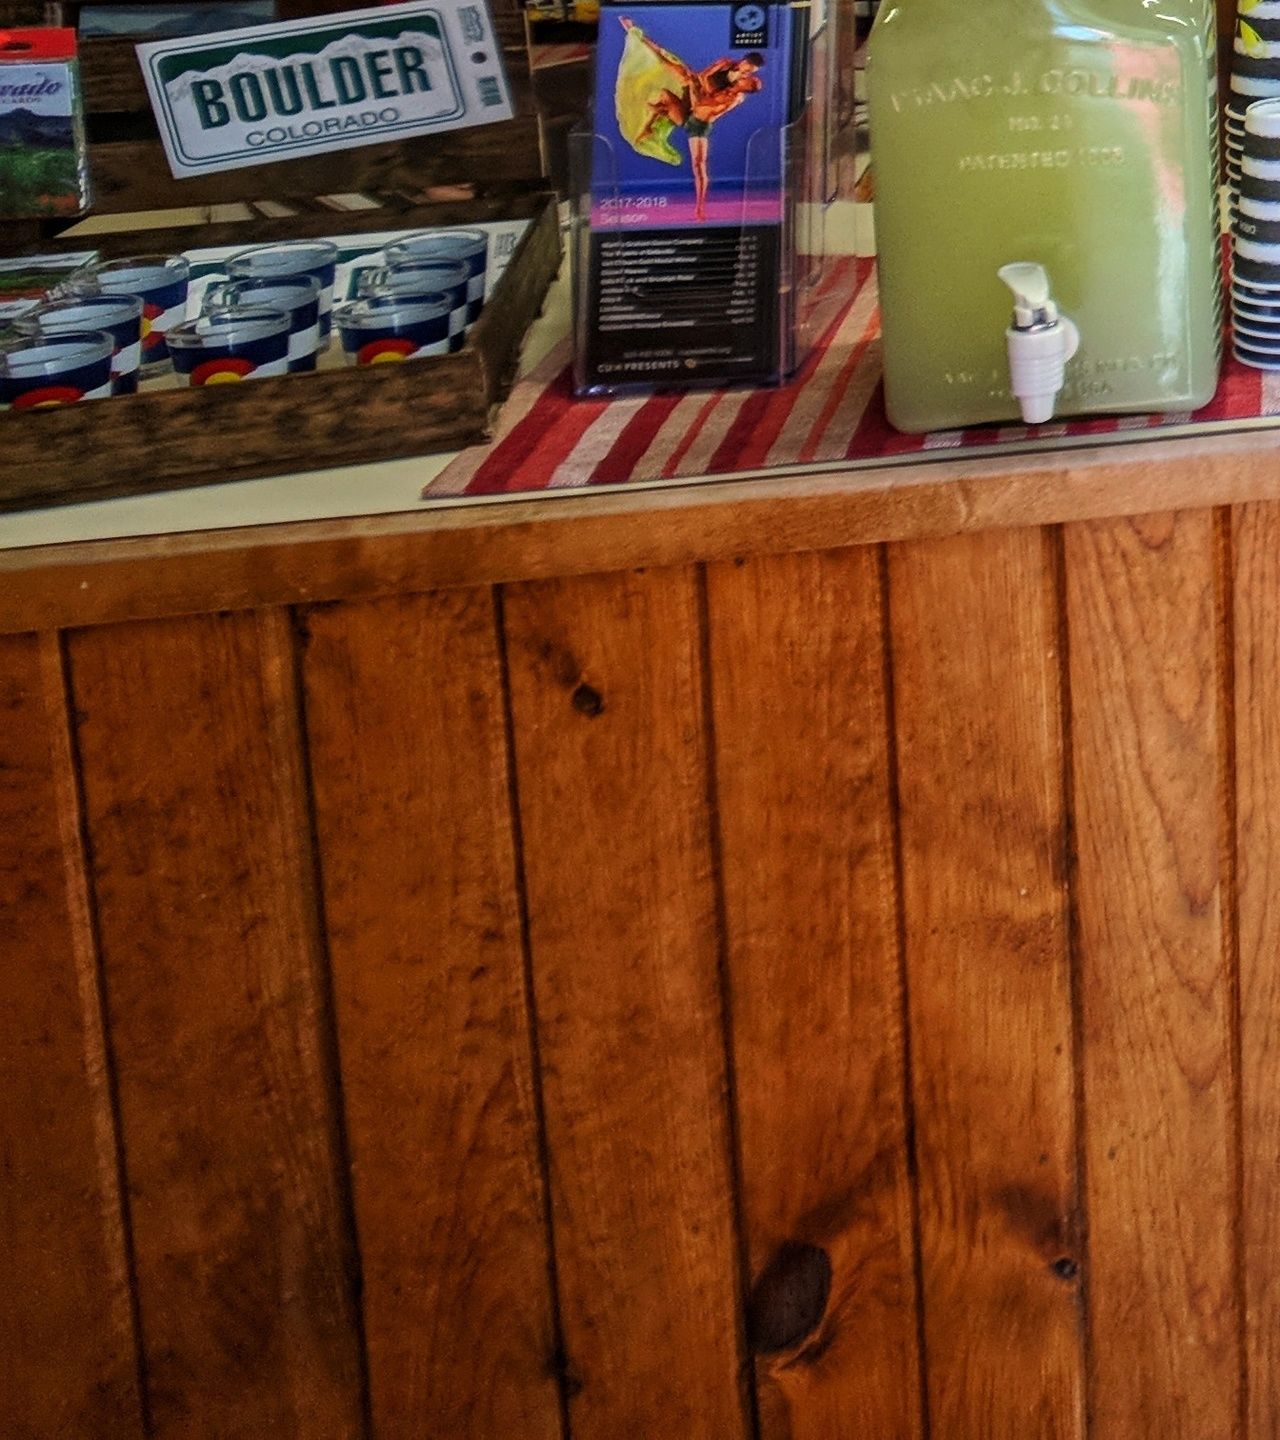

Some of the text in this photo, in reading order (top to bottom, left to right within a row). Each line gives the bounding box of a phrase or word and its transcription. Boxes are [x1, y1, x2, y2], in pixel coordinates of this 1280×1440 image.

[190, 45, 433, 130] BOULDER
[245, 106, 401, 149] COLORADO
[599, 213, 649, 225] Season
[624, 360, 681, 372] PRESENTS
